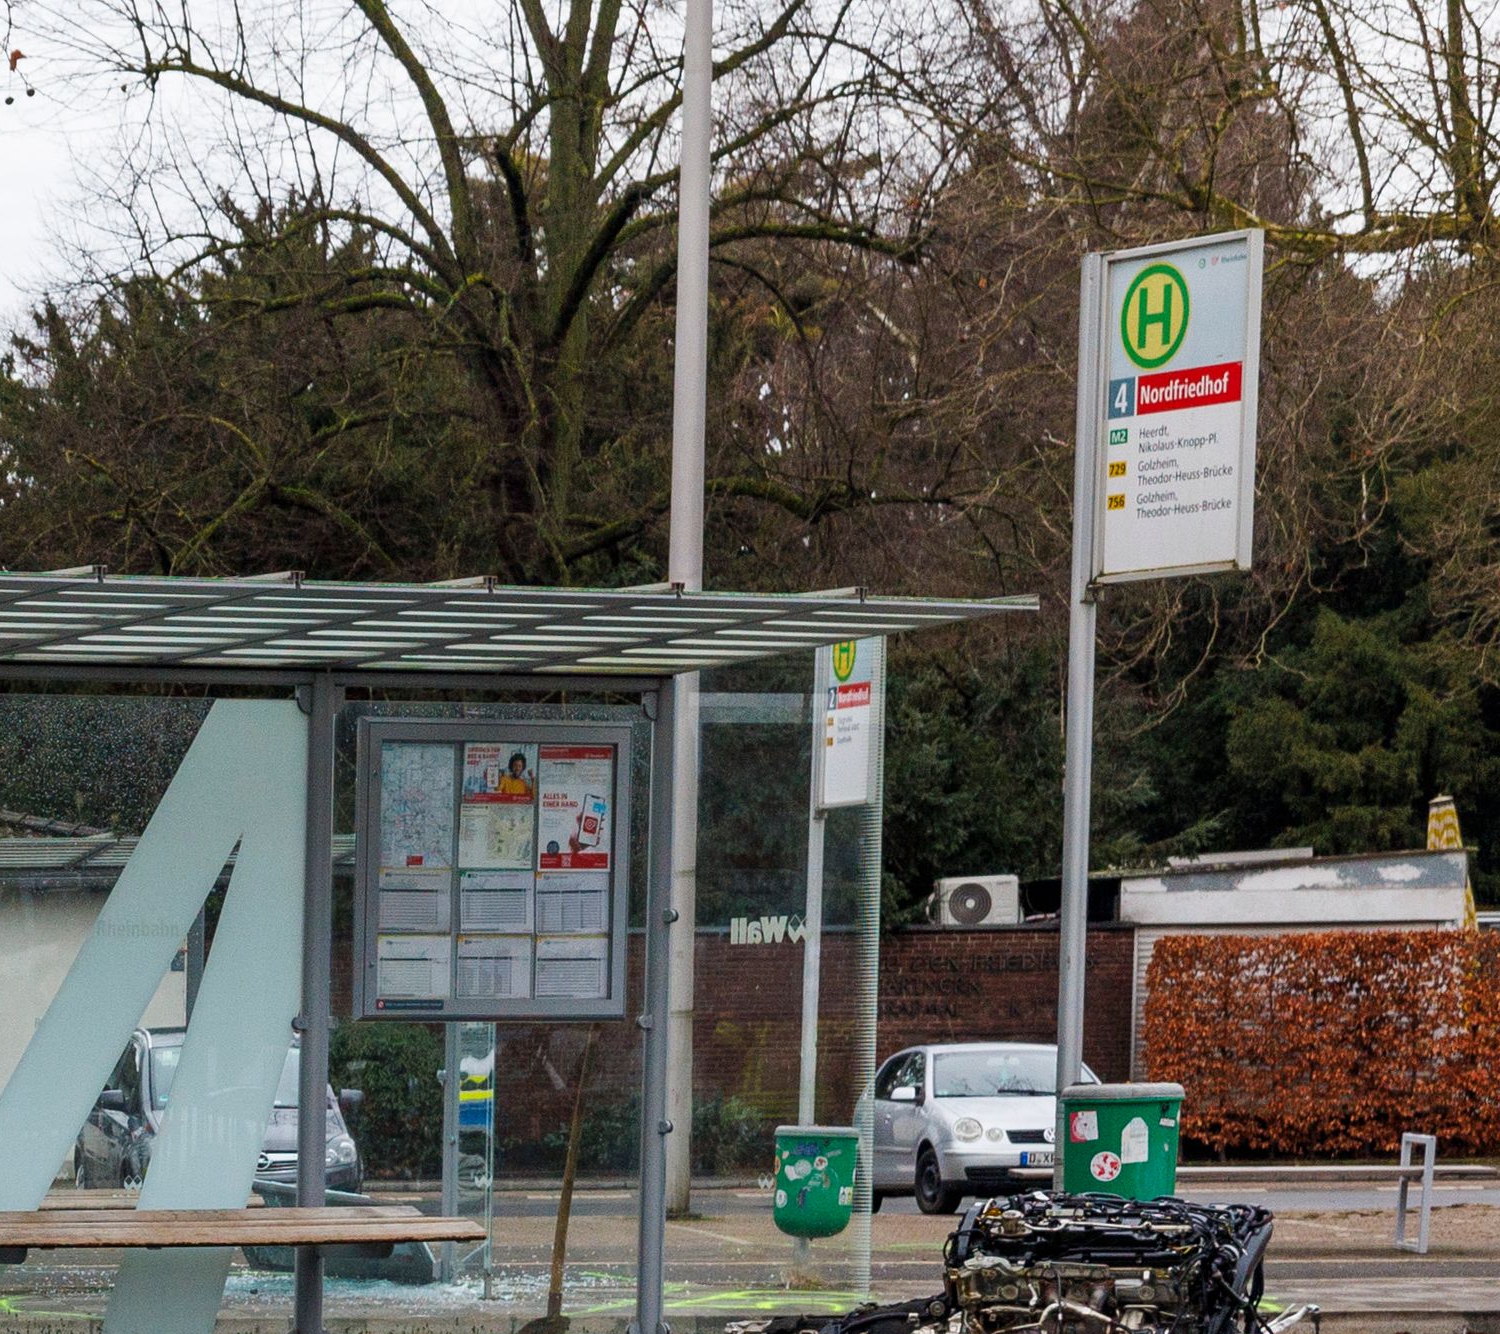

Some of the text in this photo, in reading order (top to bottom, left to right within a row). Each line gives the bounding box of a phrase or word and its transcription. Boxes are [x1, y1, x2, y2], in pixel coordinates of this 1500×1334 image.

[1114, 371, 1229, 414] 4 Nordfriedhof
[1111, 424, 1170, 443] M2 Heerdt,
[1138, 433, 1219, 454] Nikolaus-Knopp-Pl.
[1109, 458, 1179, 476] 729 Golzheim,
[1137, 464, 1233, 487] Theodor-Heuss-Brücke
[1107, 490, 1179, 509] 756 Golzheim,
[1136, 498, 1232, 520] Theodor-Heuss-Brücke
